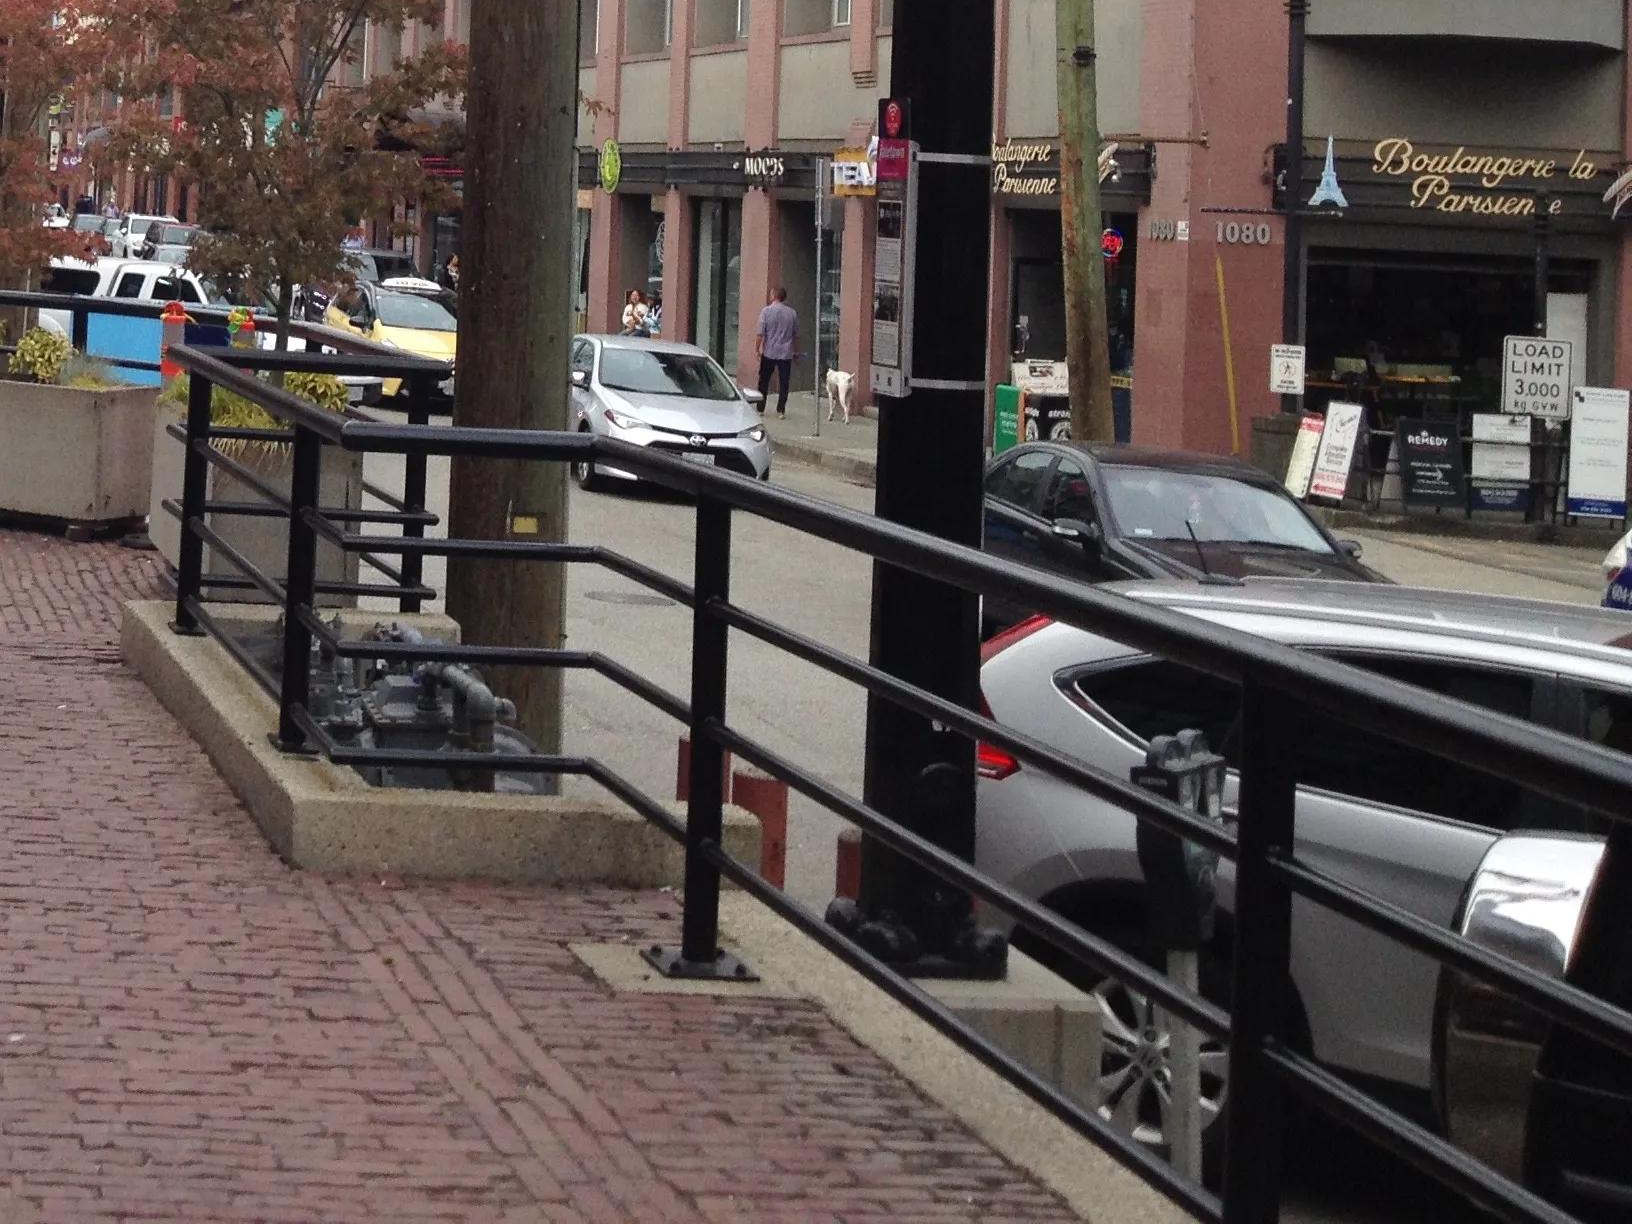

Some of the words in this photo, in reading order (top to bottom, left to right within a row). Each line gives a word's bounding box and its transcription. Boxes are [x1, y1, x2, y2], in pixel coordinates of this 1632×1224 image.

[1372, 137, 1556, 188] Boulangerie
[1568, 148, 1597, 180] la
[993, 163, 1057, 194] Parisienne
[1410, 175, 1562, 216] Parisiene
[1215, 219, 1271, 245] 1080
[1512, 343, 1564, 359] LOAD
[1511, 361, 1564, 377] LIMIT
[1407, 434, 1448, 447] REMEDY
